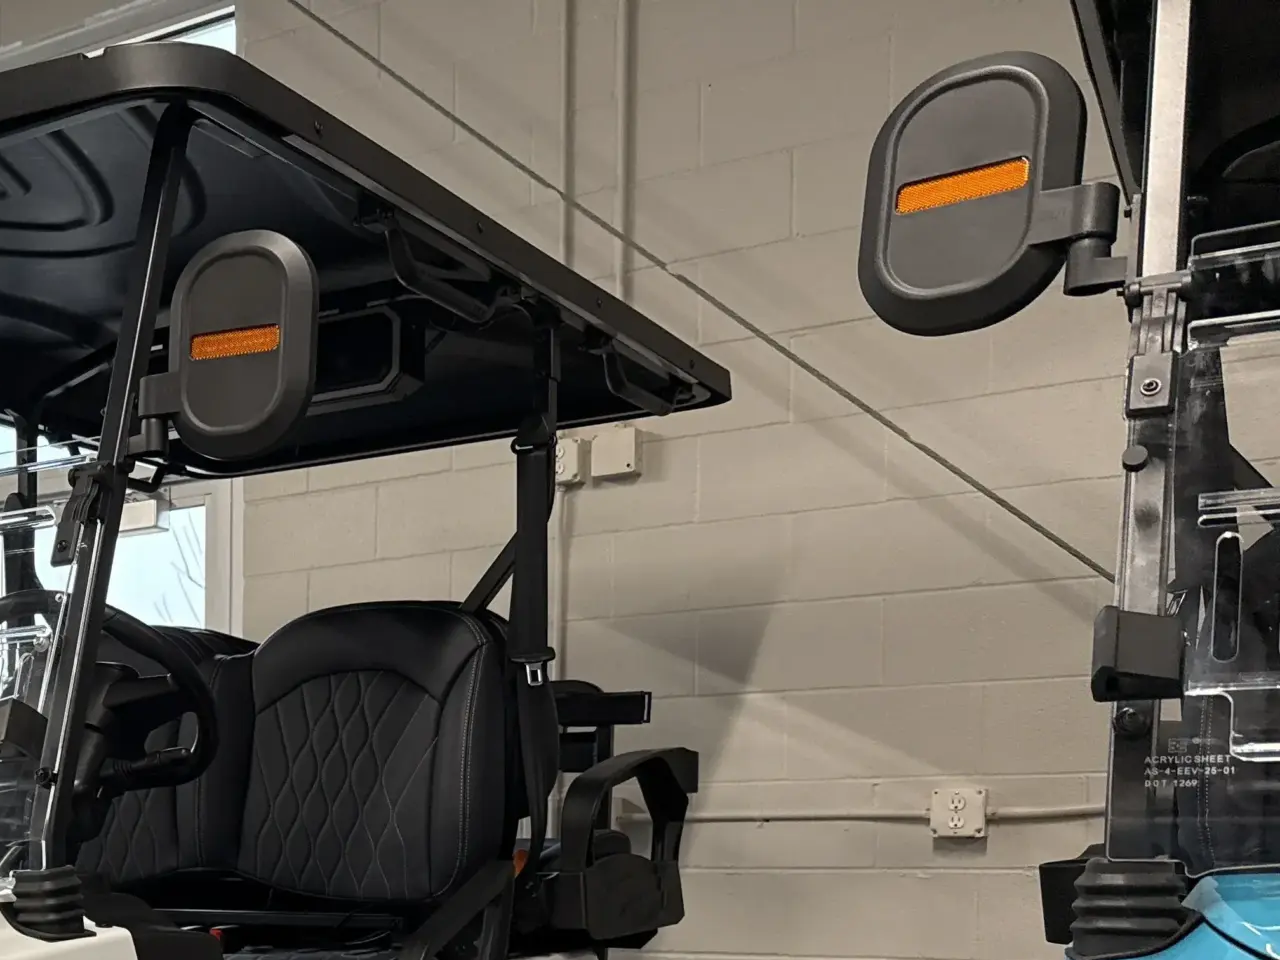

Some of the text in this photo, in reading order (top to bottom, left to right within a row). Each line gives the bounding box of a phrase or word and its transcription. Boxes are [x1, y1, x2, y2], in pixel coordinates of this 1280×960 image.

[1144, 754, 1231, 764] ACRYLIC SHEET
[1144, 779, 1198, 787] DOT 1269
